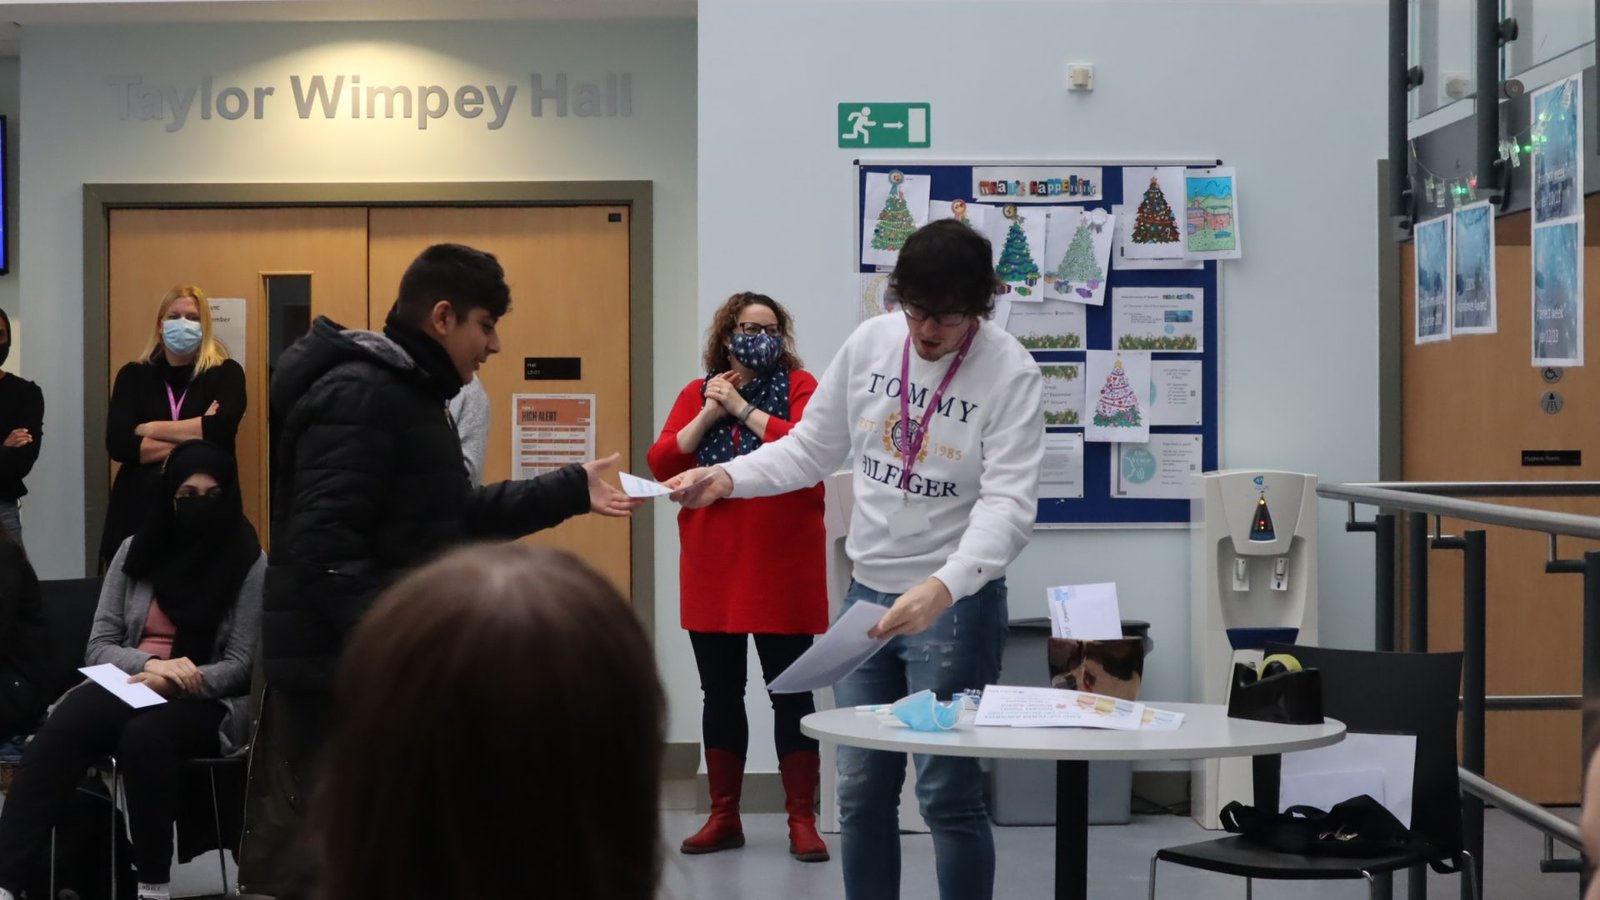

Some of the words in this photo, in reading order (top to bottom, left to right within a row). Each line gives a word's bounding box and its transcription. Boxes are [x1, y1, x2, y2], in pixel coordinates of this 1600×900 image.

[108, 75, 275, 133] Taylor
[289, 75, 518, 130] Wimpey
[530, 72, 633, 118] Hall
[538, 411, 557, 422] ALERT
[868, 372, 979, 425] TOMMY
[934, 442, 963, 461] 1985
